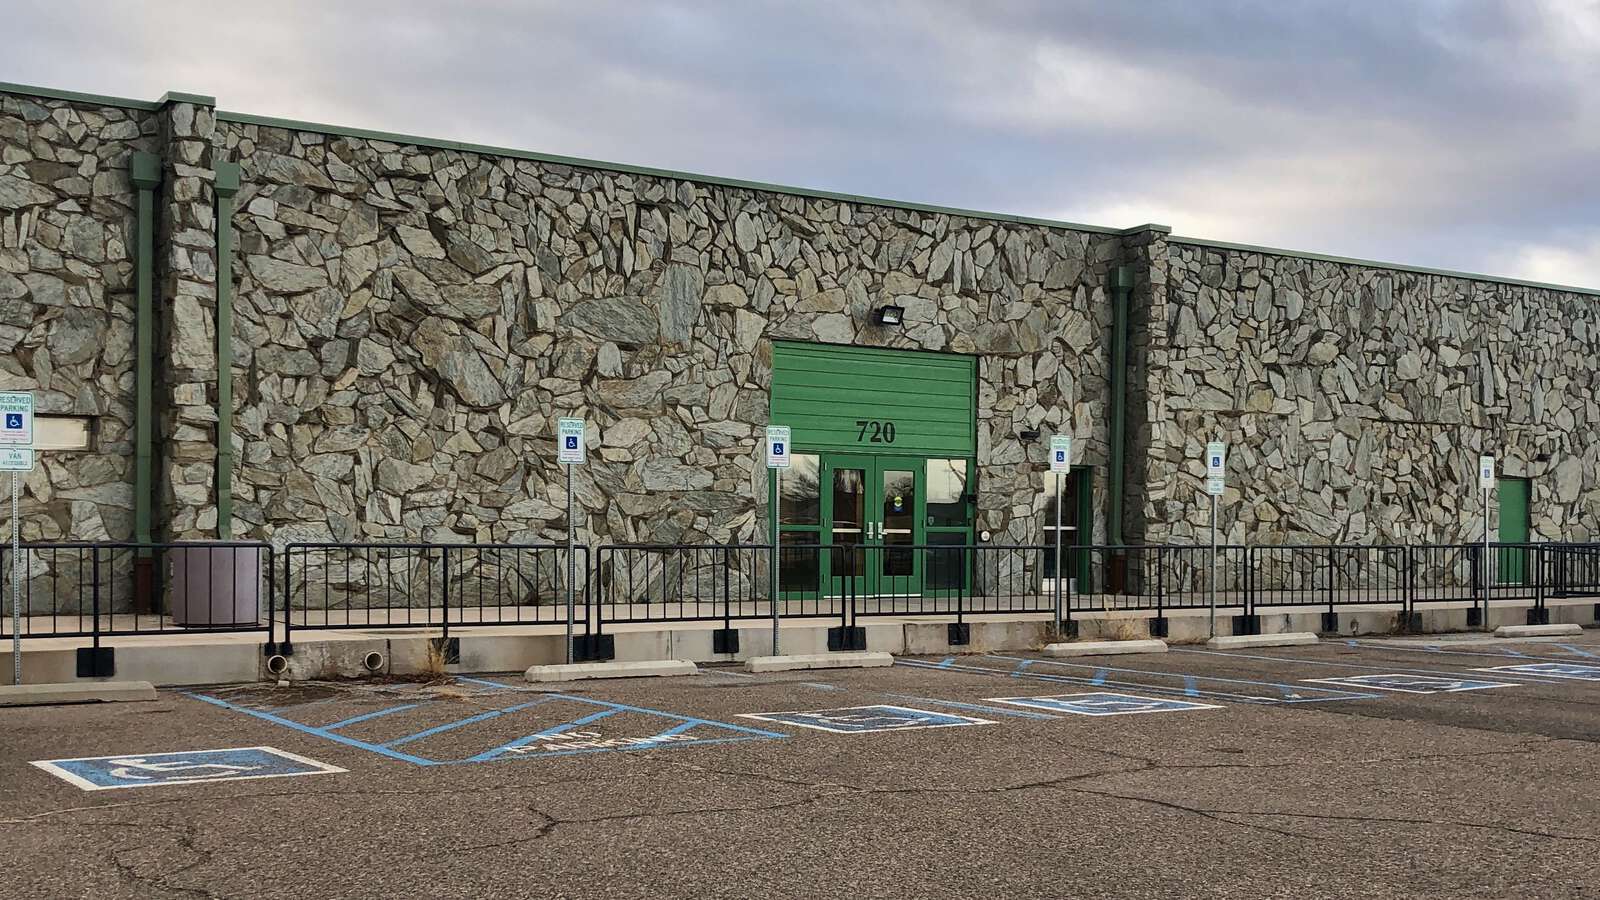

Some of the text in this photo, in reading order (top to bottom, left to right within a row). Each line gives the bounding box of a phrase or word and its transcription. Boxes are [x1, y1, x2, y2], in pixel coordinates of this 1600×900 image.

[0, 404, 29, 412] PARKING
[562, 428, 582, 436] PARKING
[855, 420, 896, 444] 720
[8, 452, 22, 460] VAN
